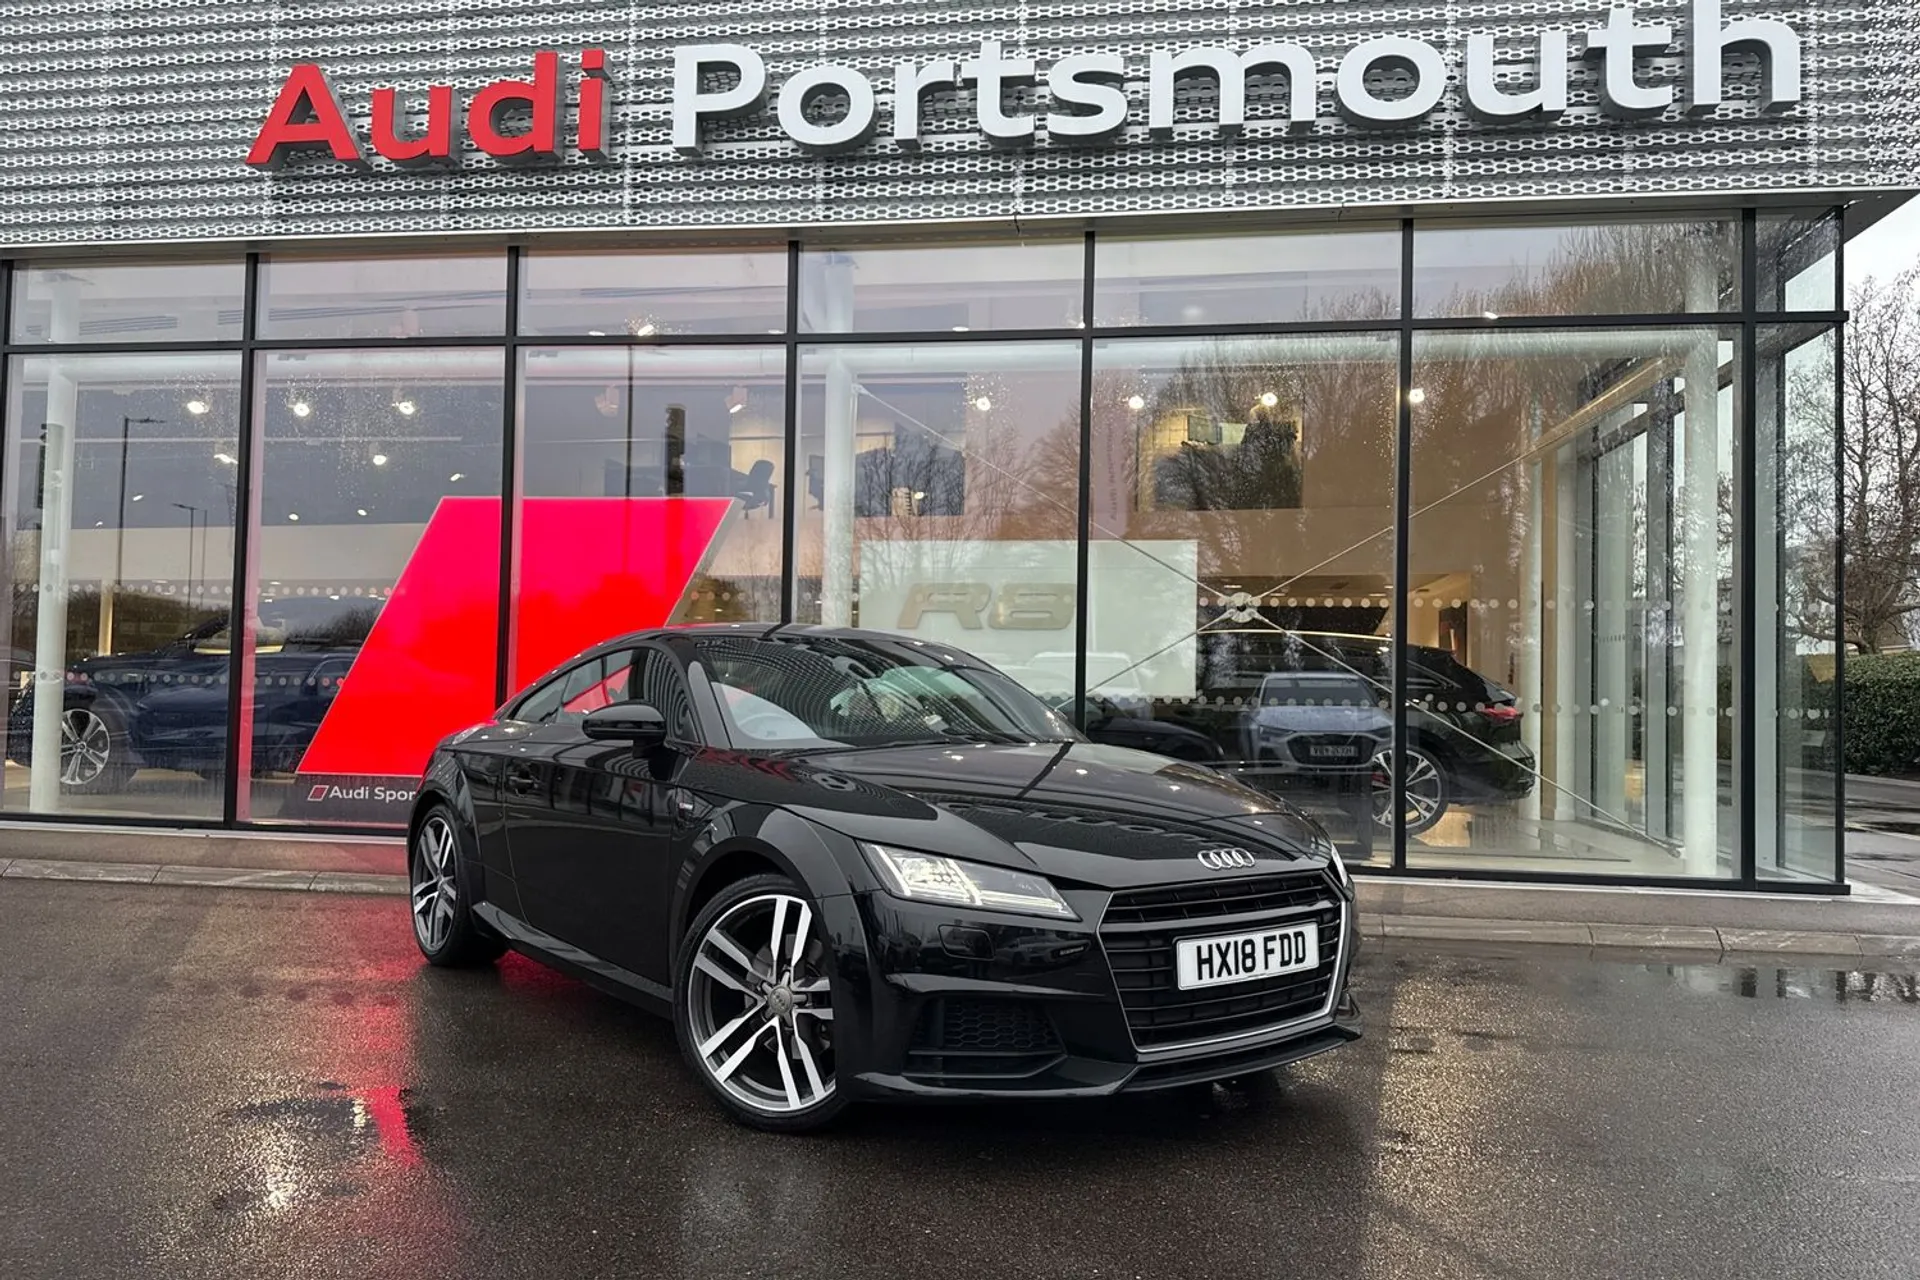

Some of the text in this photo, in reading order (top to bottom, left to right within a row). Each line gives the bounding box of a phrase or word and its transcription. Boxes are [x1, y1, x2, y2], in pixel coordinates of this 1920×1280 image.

[245, 0, 1801, 166] Audi Portsmouth
[896, 582, 1077, 630] R8
[328, 785, 417, 804] Audi Spor
[1196, 930, 1306, 981] HX18 FDD
